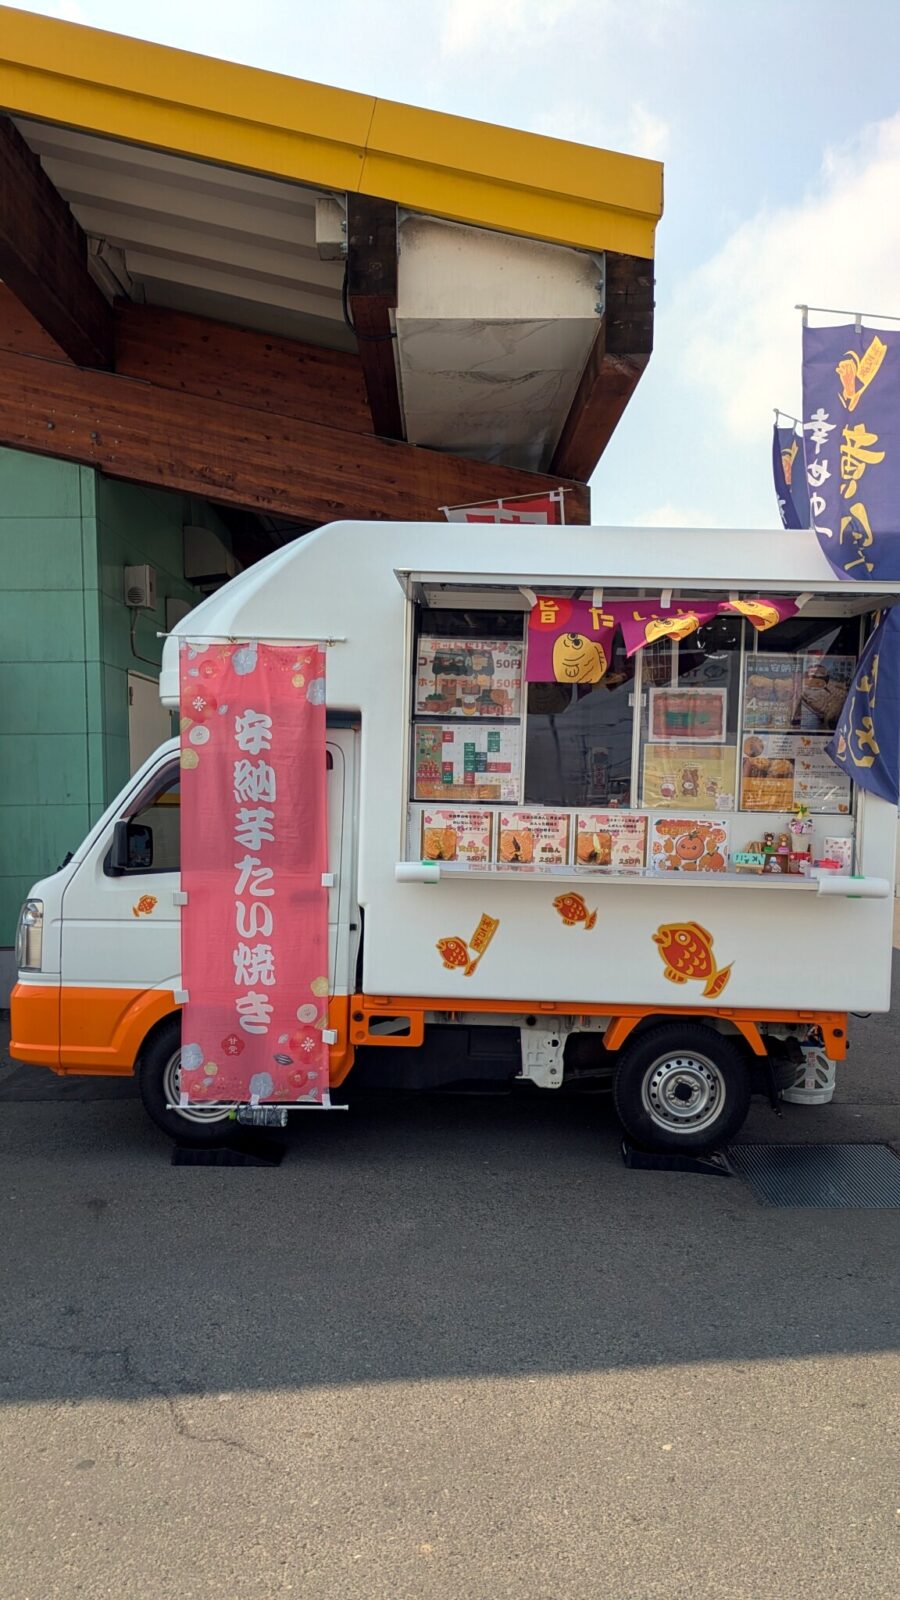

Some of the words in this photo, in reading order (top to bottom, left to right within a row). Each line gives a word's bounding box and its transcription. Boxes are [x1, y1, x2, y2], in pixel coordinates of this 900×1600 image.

[233, 708, 277, 1035] 安納芋たい焼き
[539, 856, 563, 864] 250円
